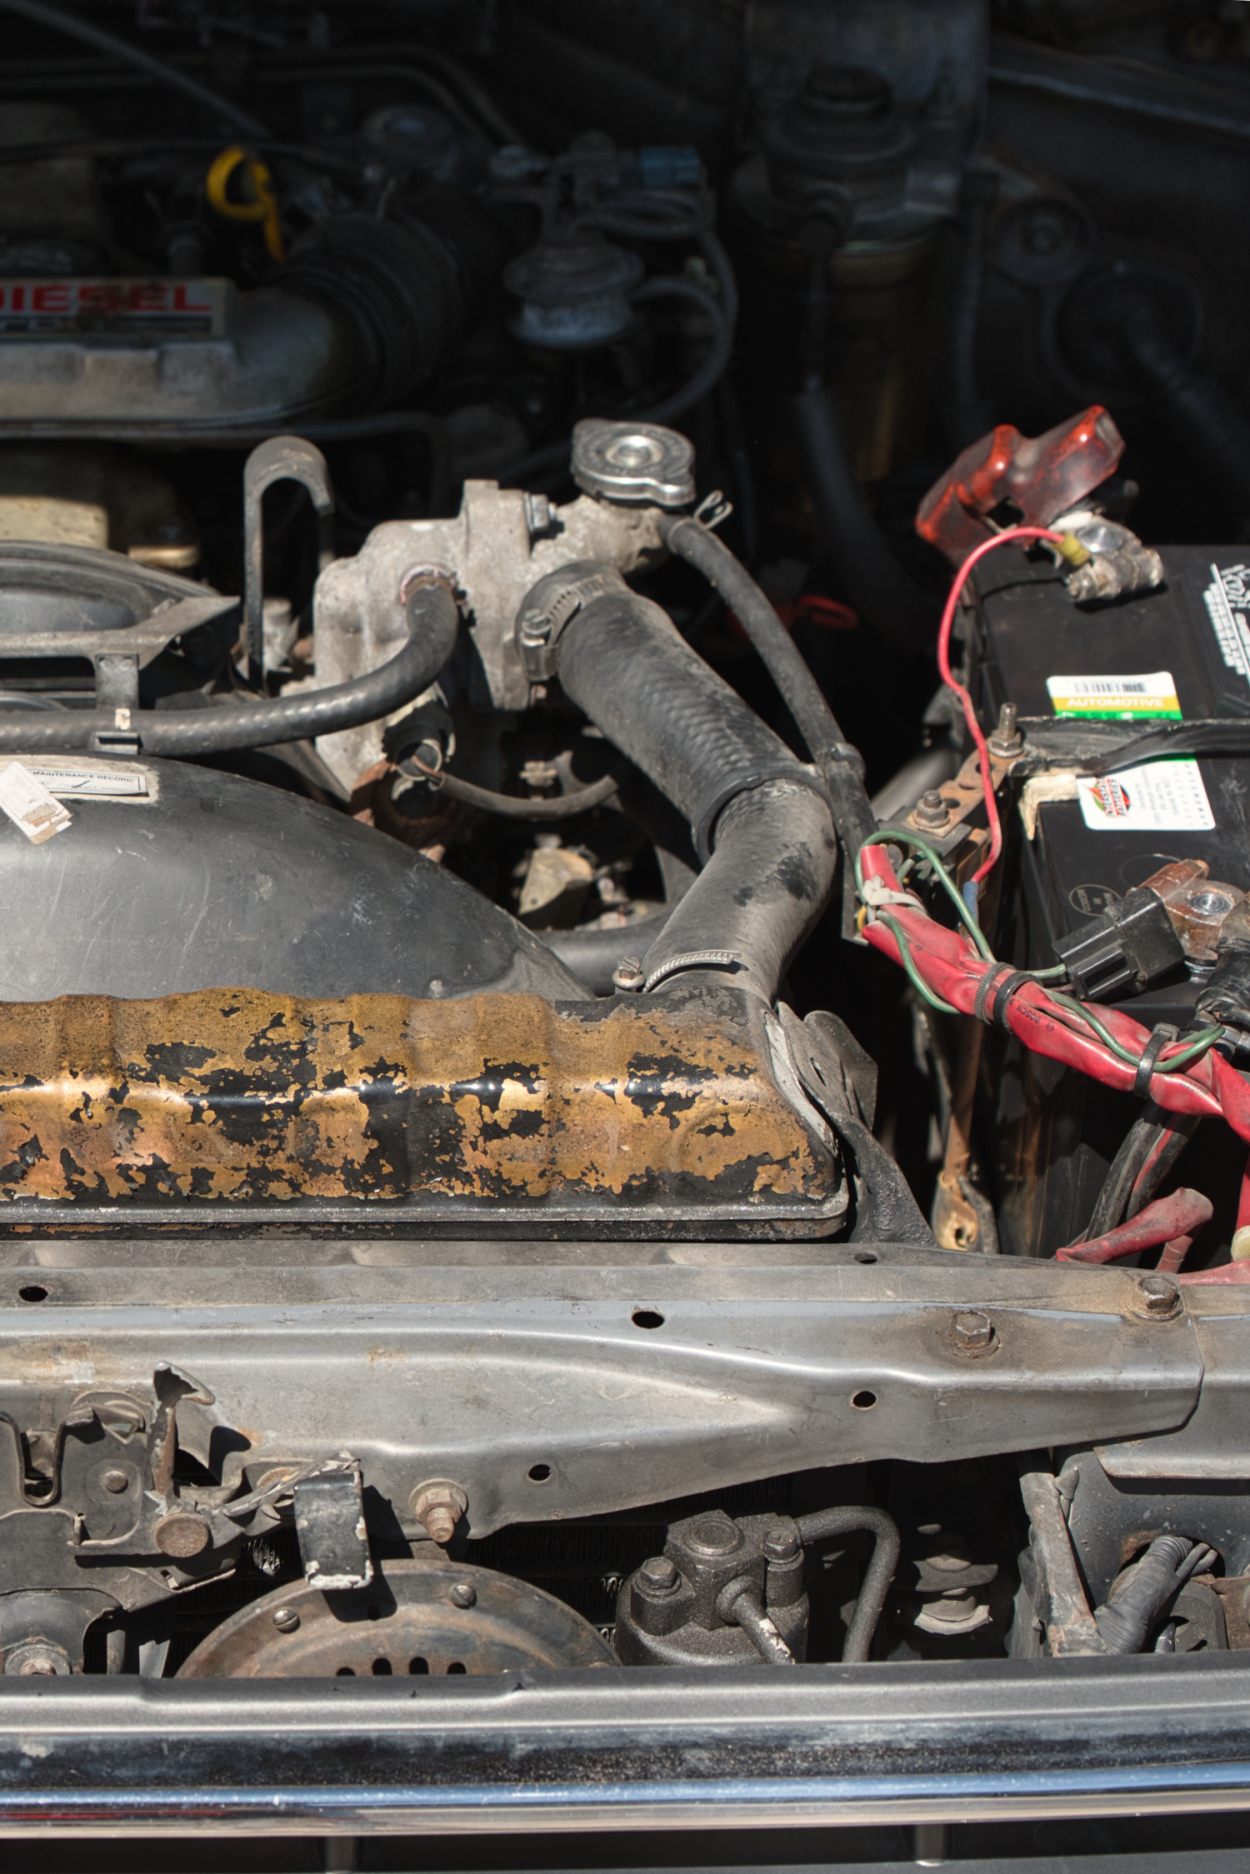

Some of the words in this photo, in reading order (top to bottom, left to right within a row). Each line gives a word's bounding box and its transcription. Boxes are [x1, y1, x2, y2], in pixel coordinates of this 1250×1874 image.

[1067, 697, 1165, 708] AUTOMOTIVE
[1109, 779, 1127, 817] BATTERIES
[1016, 1004, 1041, 1024] BOSCH
